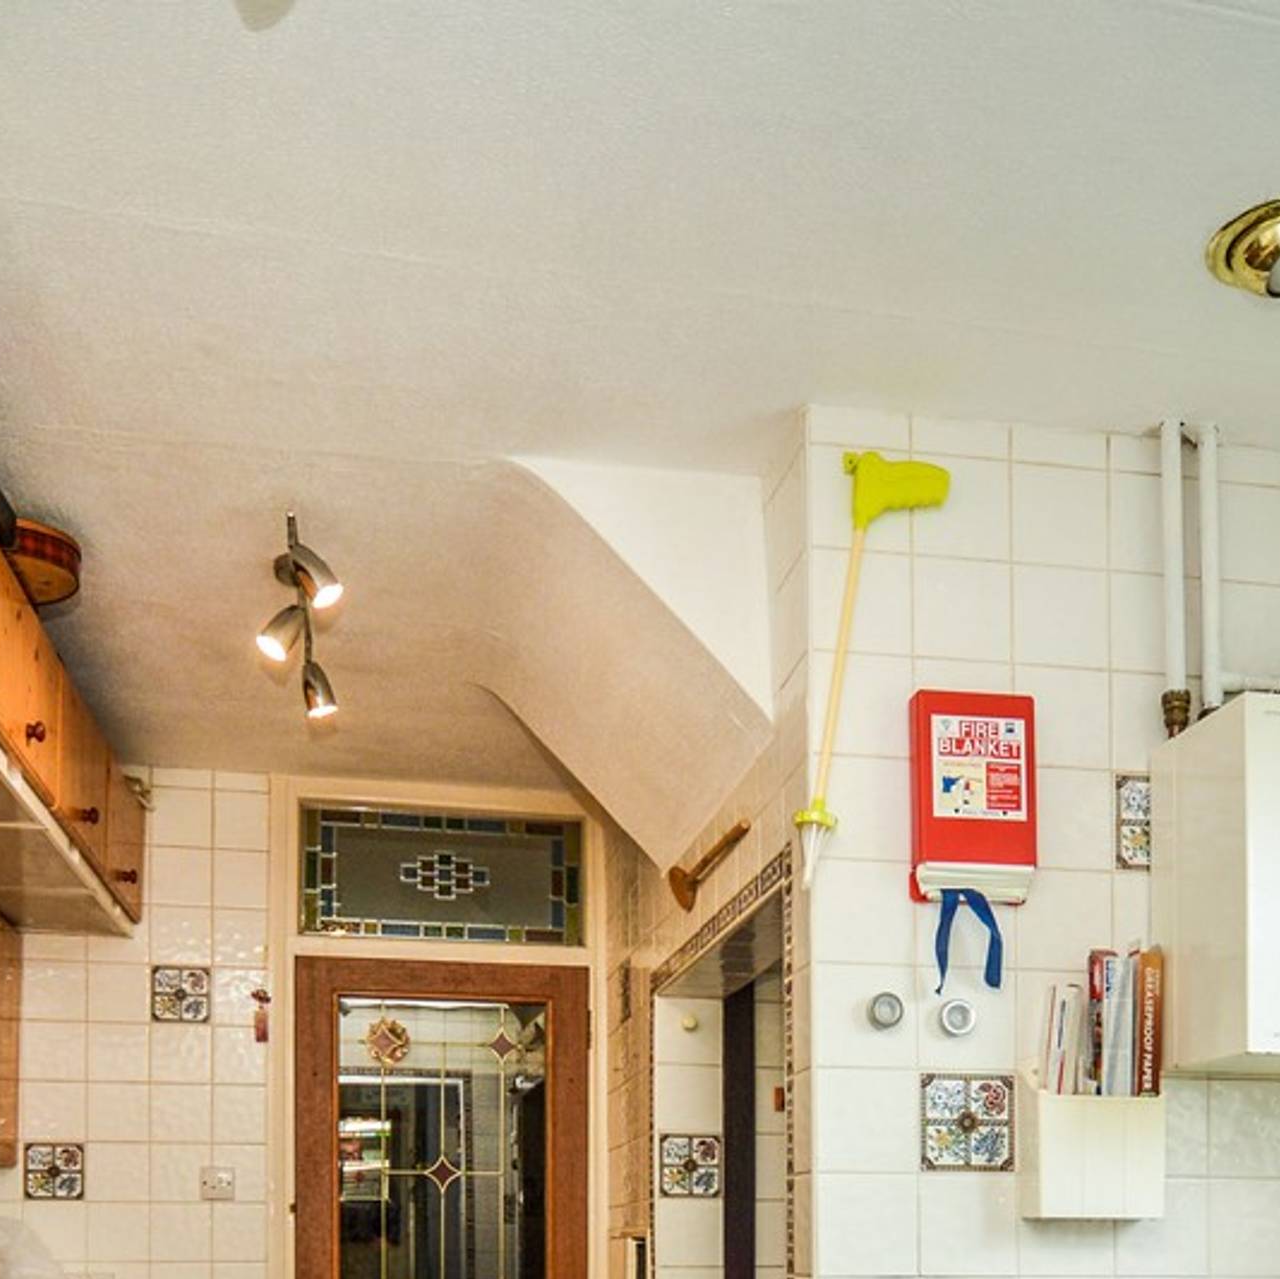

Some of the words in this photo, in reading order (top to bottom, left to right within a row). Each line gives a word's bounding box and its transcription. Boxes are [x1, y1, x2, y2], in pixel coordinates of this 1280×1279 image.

[960, 721, 999, 738] FIRE
[938, 737, 1021, 759] BLANKET
[1143, 966, 1154, 1052] GREASEPROOF
[1142, 1053, 1153, 1089] PAPER
